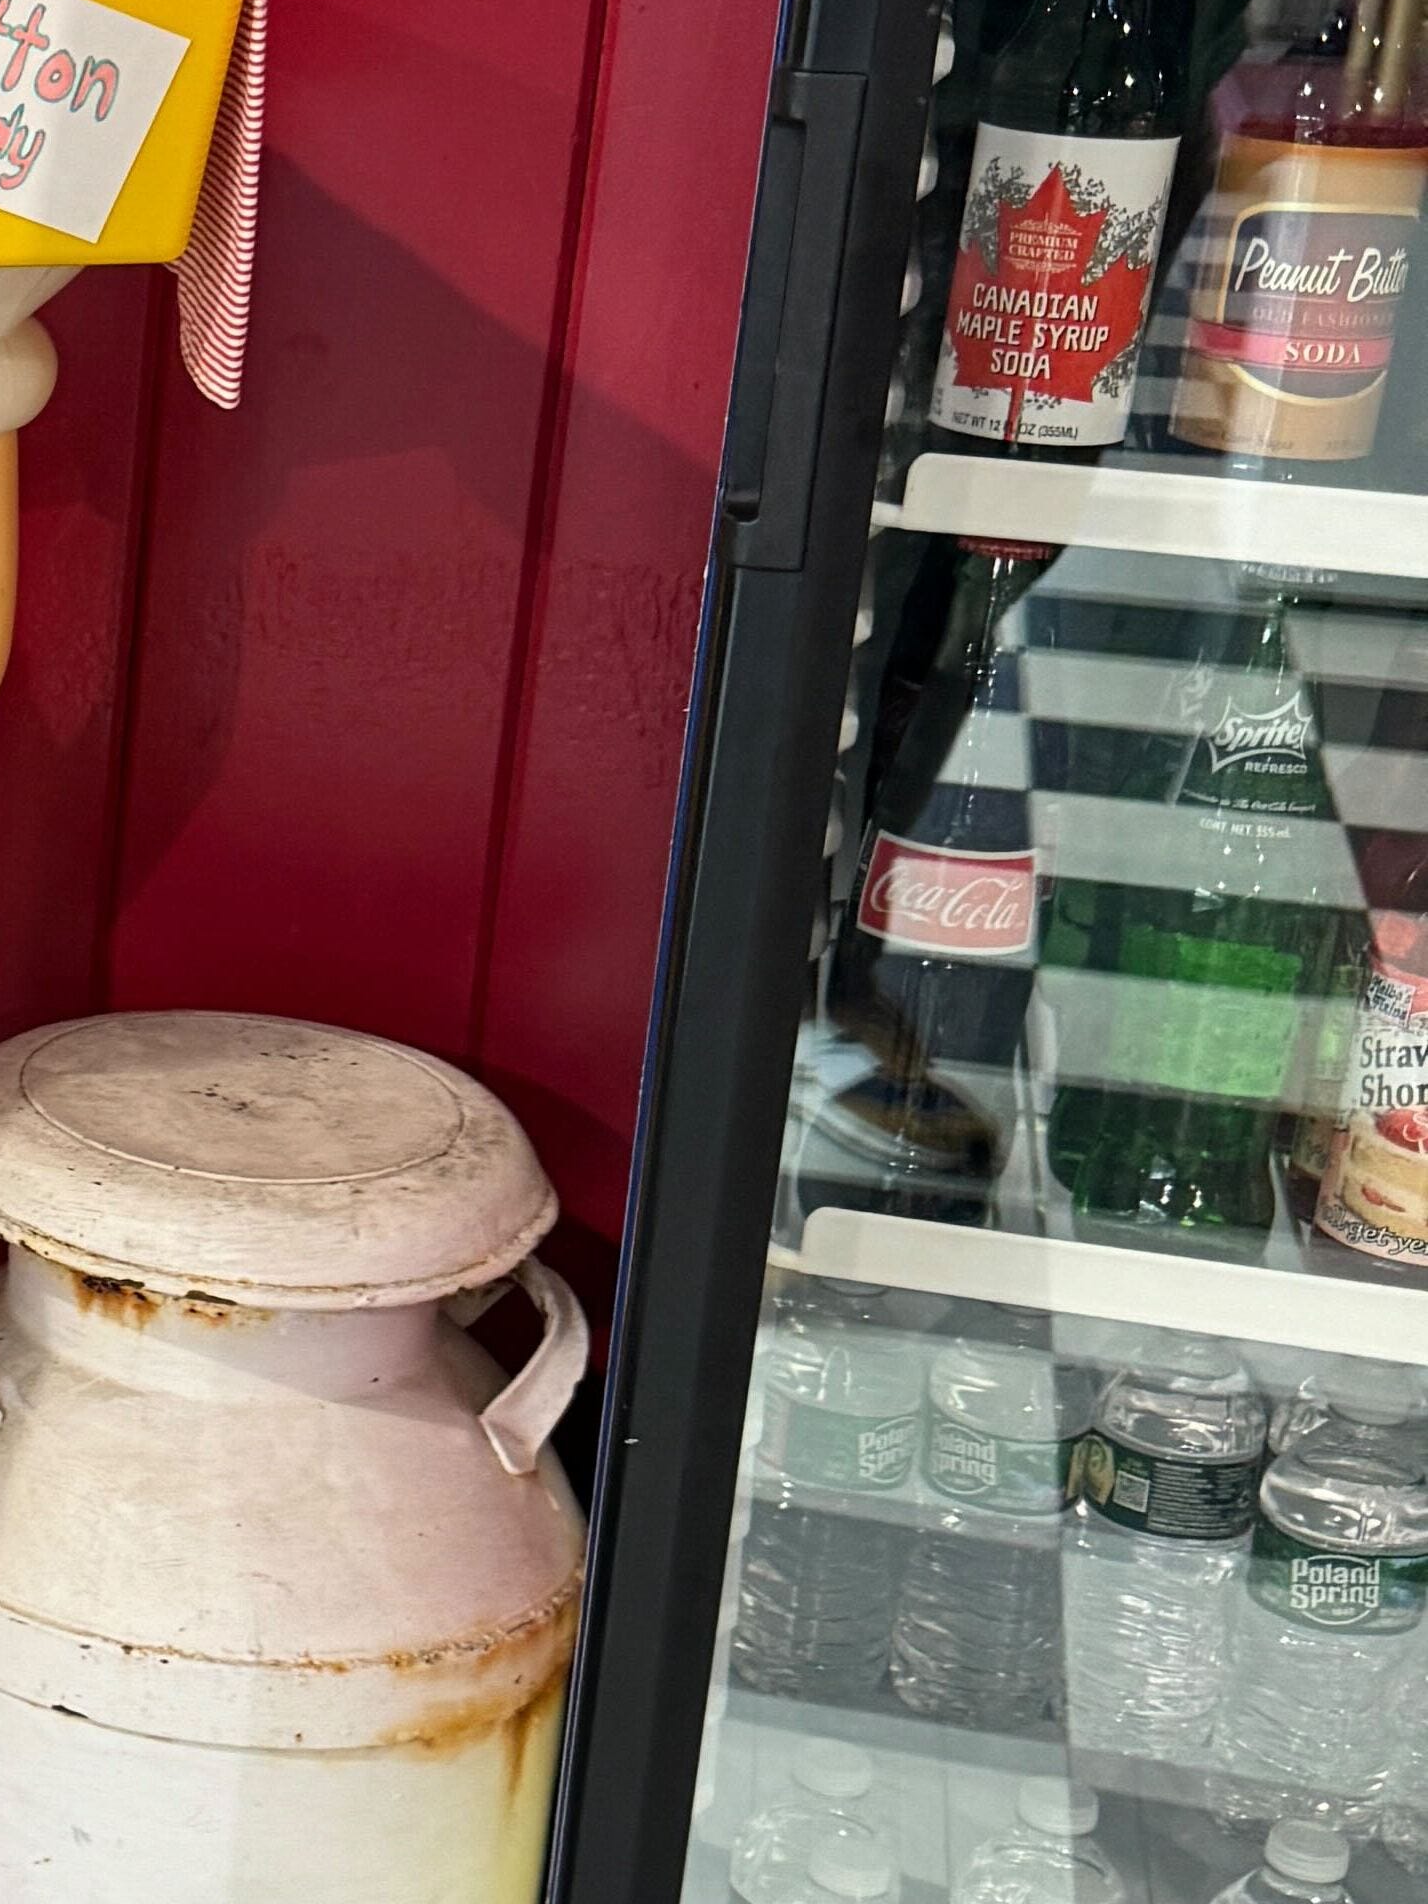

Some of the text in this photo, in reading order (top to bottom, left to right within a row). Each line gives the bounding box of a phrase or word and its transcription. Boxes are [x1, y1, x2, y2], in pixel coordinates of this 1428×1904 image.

[1008, 244, 1075, 262] CRAFTED
[1009, 231, 1079, 249] PREMIUM
[1234, 237, 1353, 293] Peanut
[973, 283, 1099, 322] CANADIAN
[955, 309, 1109, 352] MAPLE SYRUP
[990, 348, 1051, 380] SODA
[1282, 342, 1361, 364] SODA
[951, 412, 970, 424] NET
[971, 415, 986, 428] WT
[988, 418, 1001, 432] 12
[1214, 716, 1302, 752] Sprite
[1244, 761, 1308, 774] REFRESCO
[870, 863, 1023, 929] Coca-Cola
[1291, 1558, 1380, 1586] Poland
[1289, 1583, 1379, 1611] Spring
